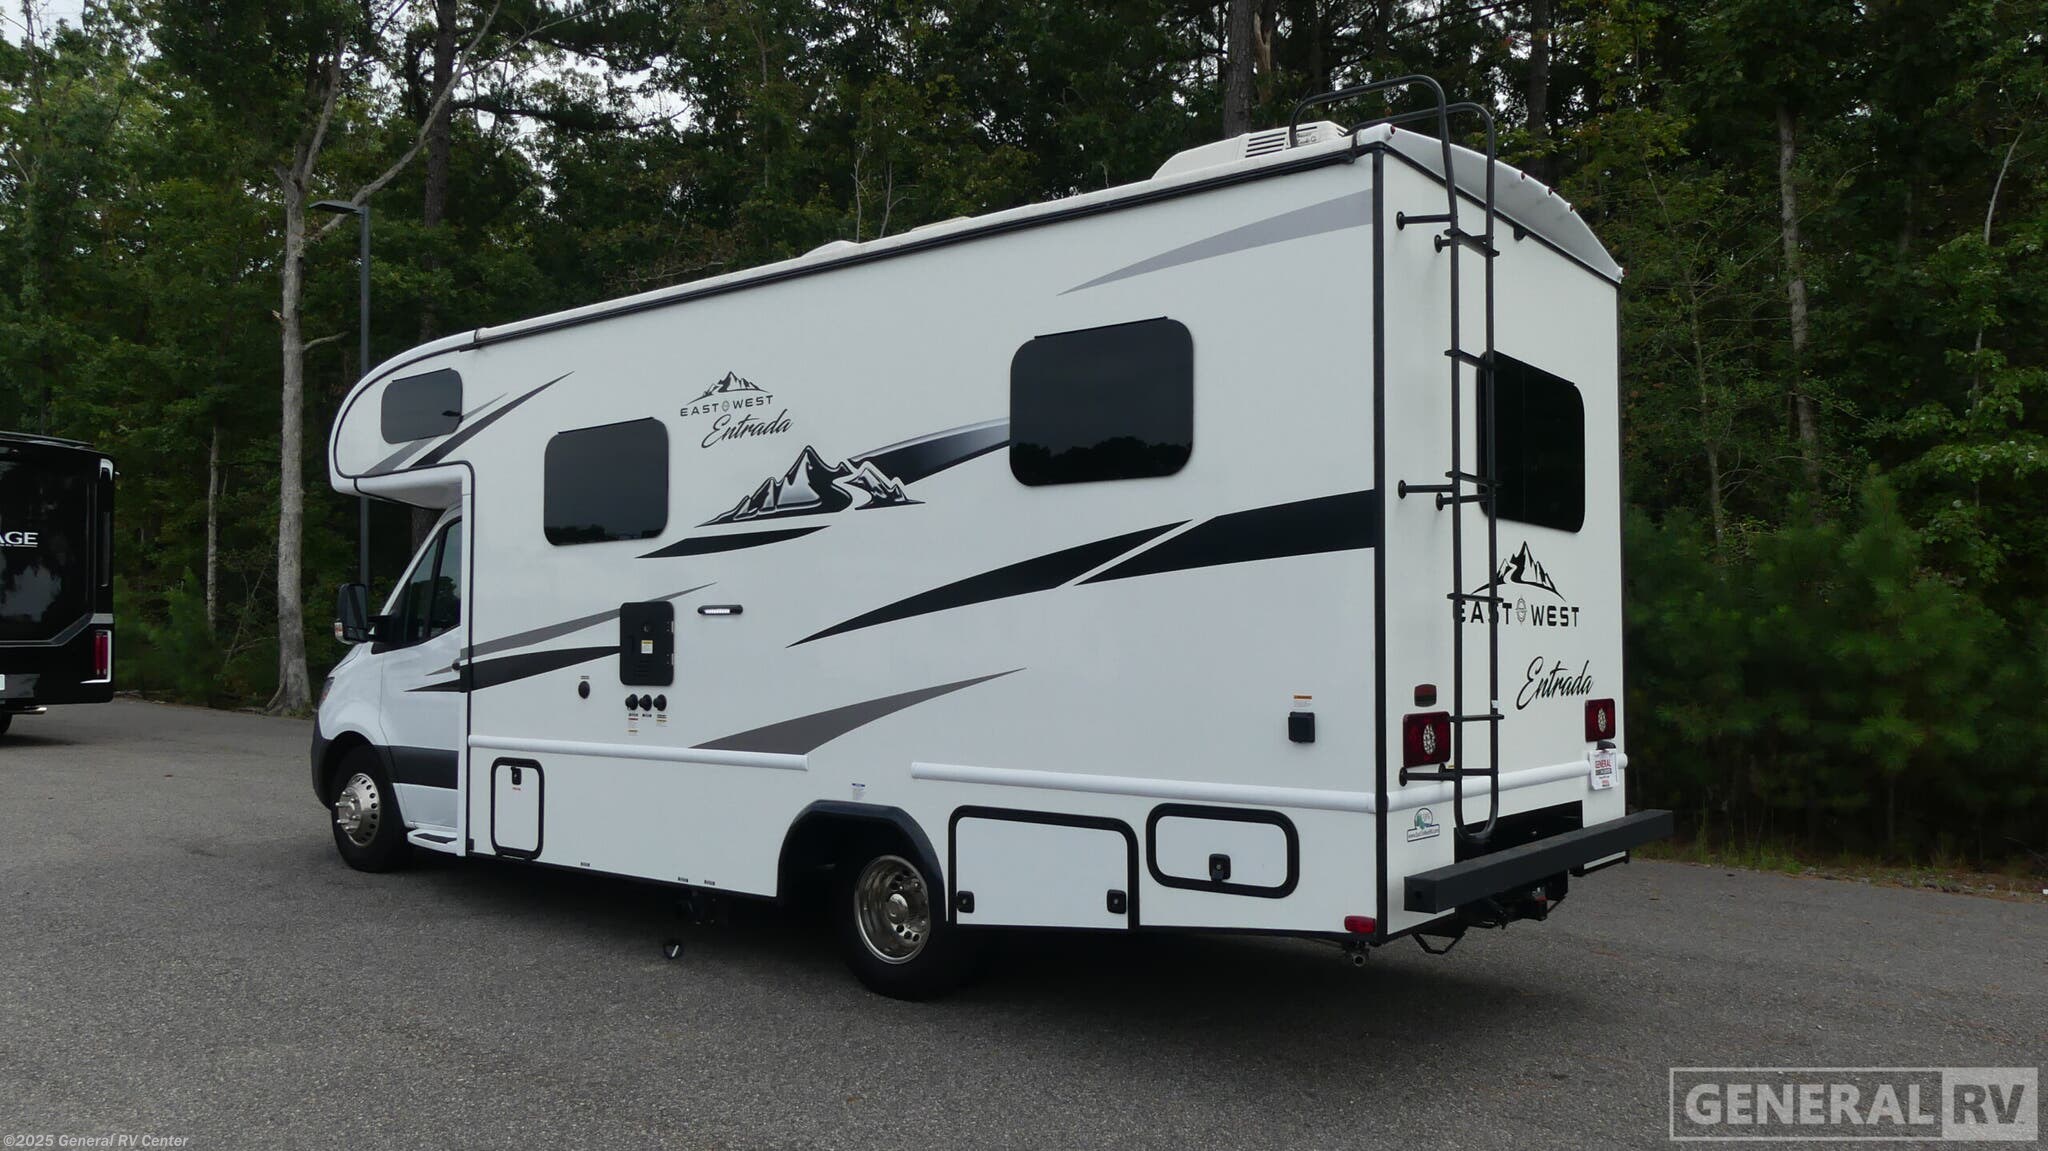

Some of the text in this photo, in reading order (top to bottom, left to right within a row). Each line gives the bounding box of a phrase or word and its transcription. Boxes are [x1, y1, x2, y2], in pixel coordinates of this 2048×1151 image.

[680, 395, 773, 417] EAST WEST
[701, 408, 794, 448] Entrada
[1531, 604, 1580, 627] WEST
[1516, 656, 1593, 710] Entrada
